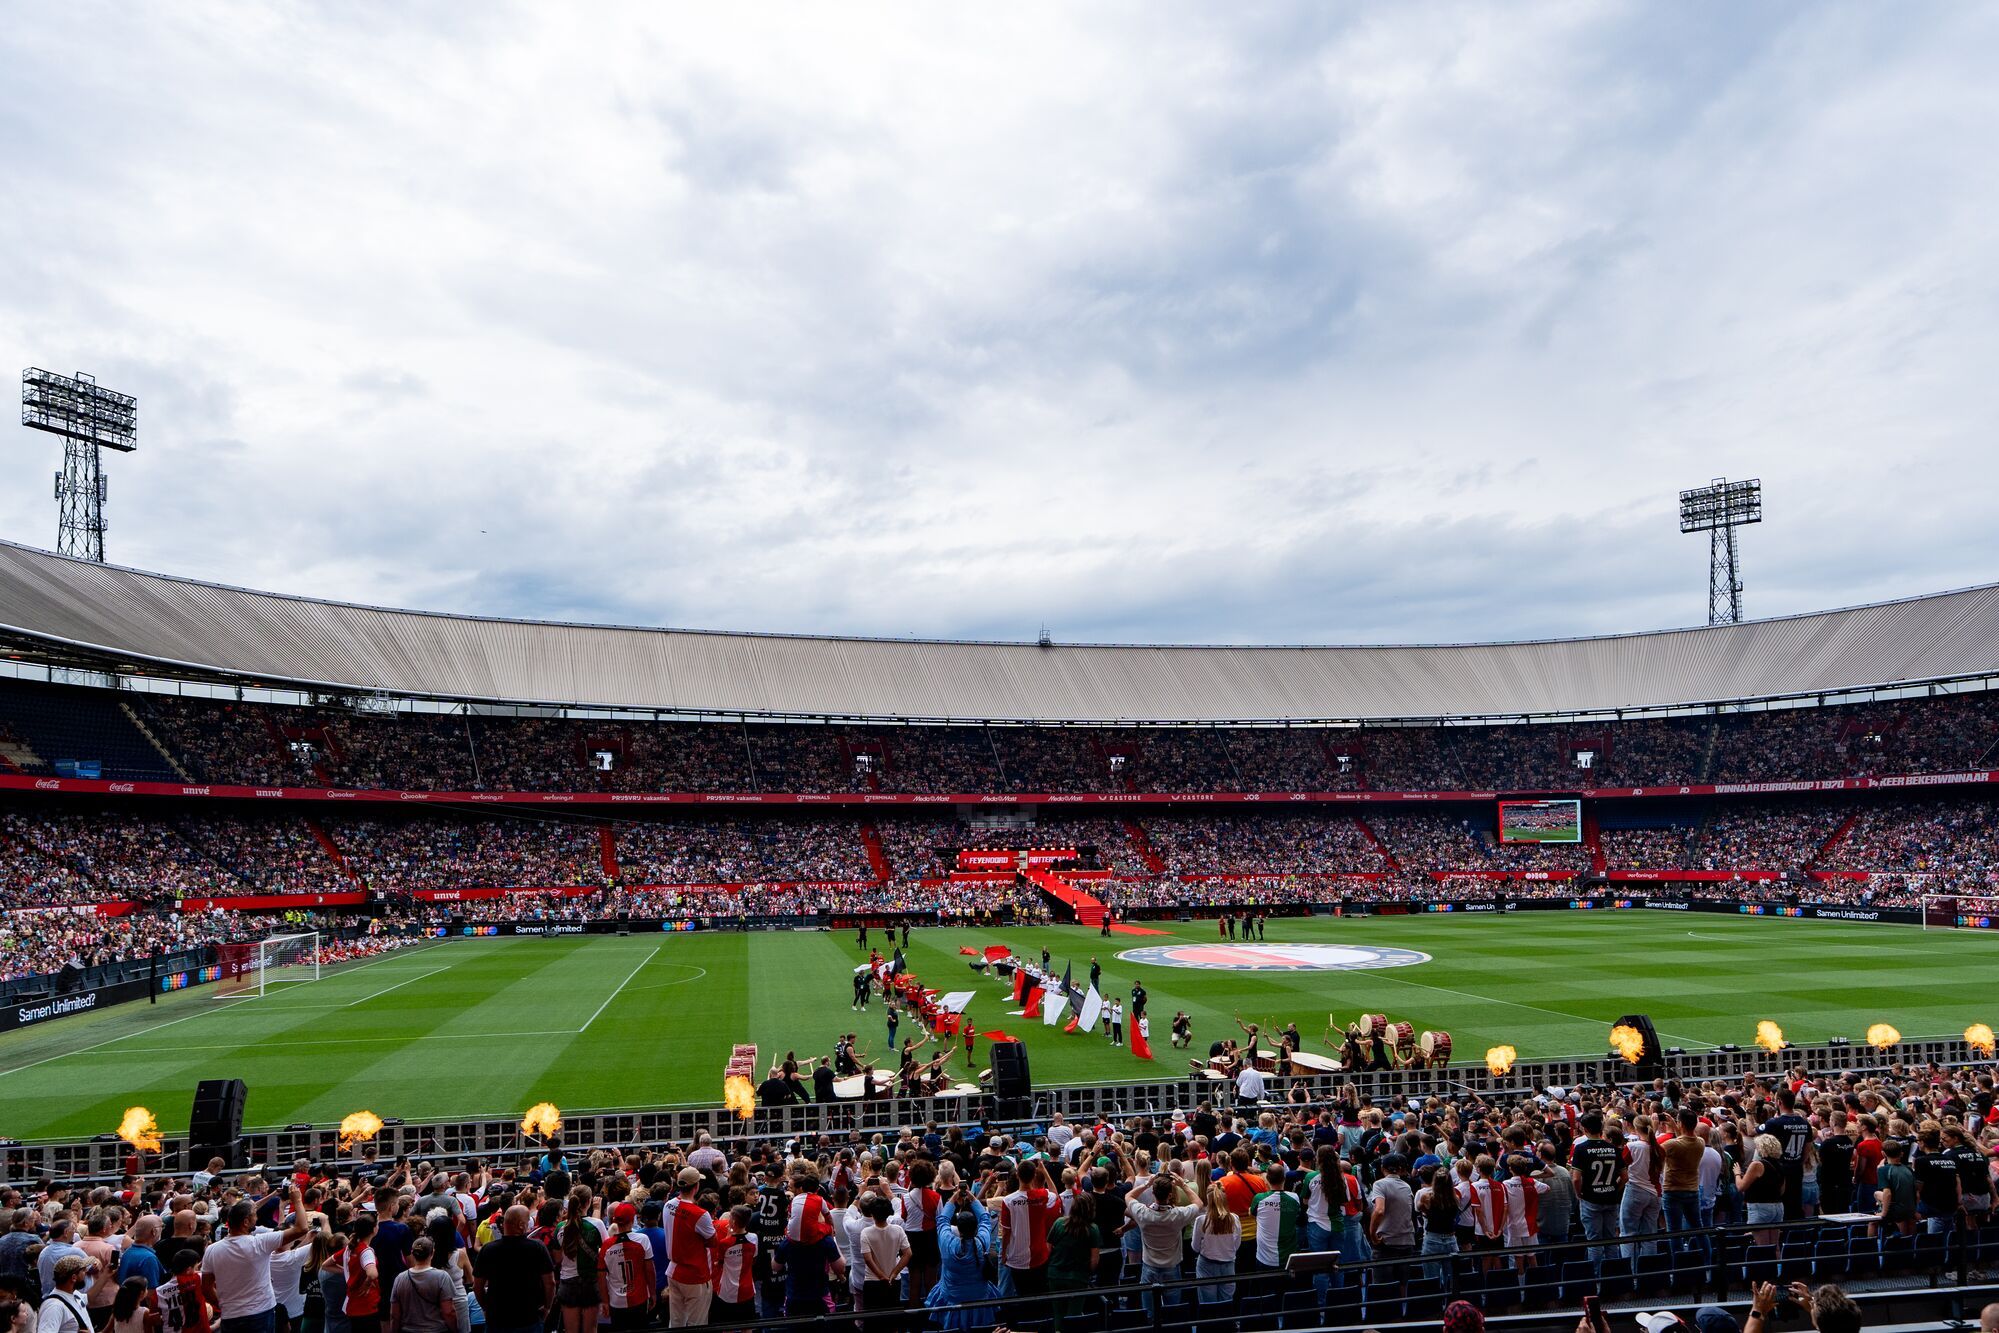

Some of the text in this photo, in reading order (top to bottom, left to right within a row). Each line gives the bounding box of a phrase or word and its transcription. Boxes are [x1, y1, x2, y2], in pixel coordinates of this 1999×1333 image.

[1880, 776, 1905, 787] KEER
[1905, 772, 1989, 786] BEKERWINNAAR
[182, 785, 210, 795] univé
[1715, 783, 1760, 793] WINNAAR
[1821, 780, 1845, 789] 1970
[256, 788, 283, 798] univé
[327, 790, 355, 798] Quooker
[400, 792, 428, 800] Quooker
[969, 856, 1009, 864] FEYENOORD
[433, 890, 461, 900] univé
[1662, 902, 1689, 910] Unlimited?
[1817, 909, 1879, 920] Samen Unlimited?
[515, 925, 544, 933] Samen
[19, 993, 96, 1022] Samen Unlimited?
[1591, 1160, 1616, 1186] 27
[759, 1194, 779, 1218] 25
[617, 1260, 634, 1285] 11
